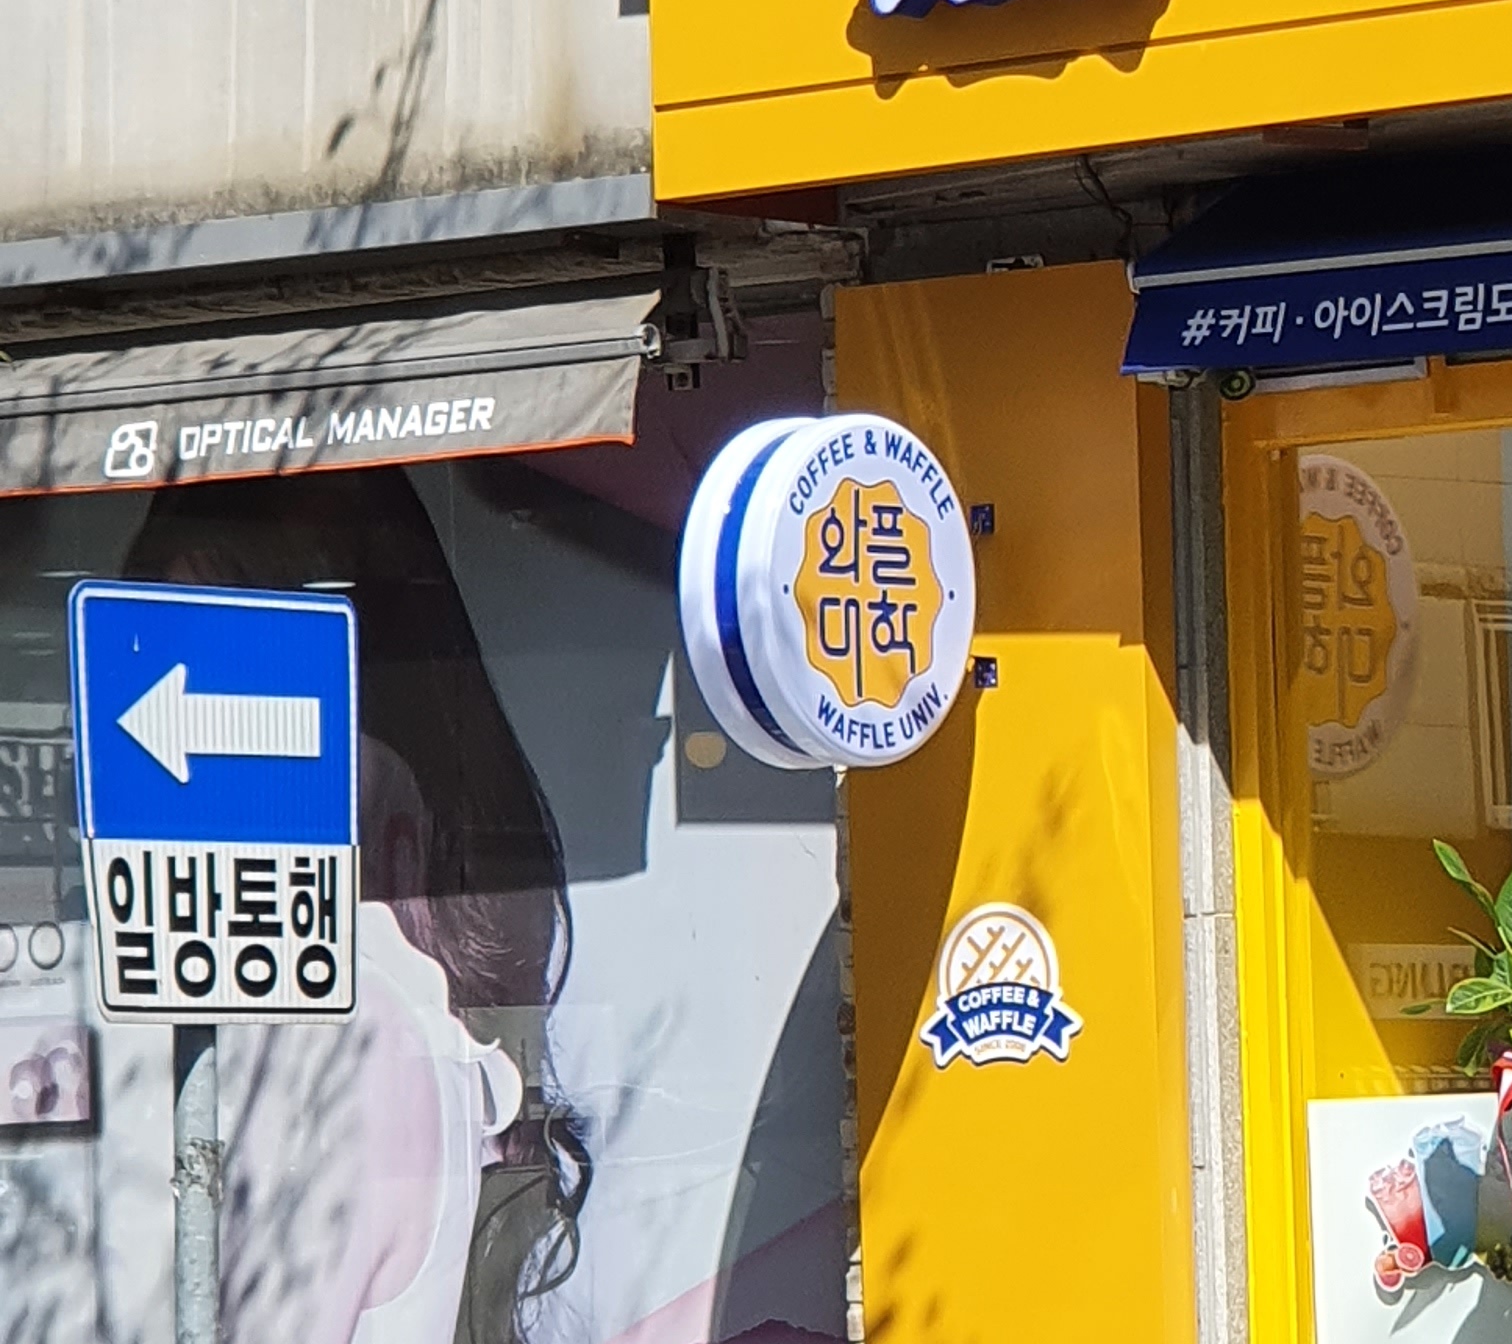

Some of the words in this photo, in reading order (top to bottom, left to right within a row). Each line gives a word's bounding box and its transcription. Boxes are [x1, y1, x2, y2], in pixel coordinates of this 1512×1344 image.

[179, 415, 313, 461] OPTICAL
[328, 397, 495, 445] MANAGER
[789, 432, 855, 516] COFFEE
[864, 429, 877, 456] &
[885, 430, 955, 521] WAFFLE
[817, 488, 917, 583] 와플
[818, 694, 896, 750] WAFFLE
[899, 683, 949, 740] UNIV.
[107, 851, 338, 999] 일방통행
[958, 986, 1025, 1012] COFFEE
[962, 1010, 1037, 1039] WAFFLE
